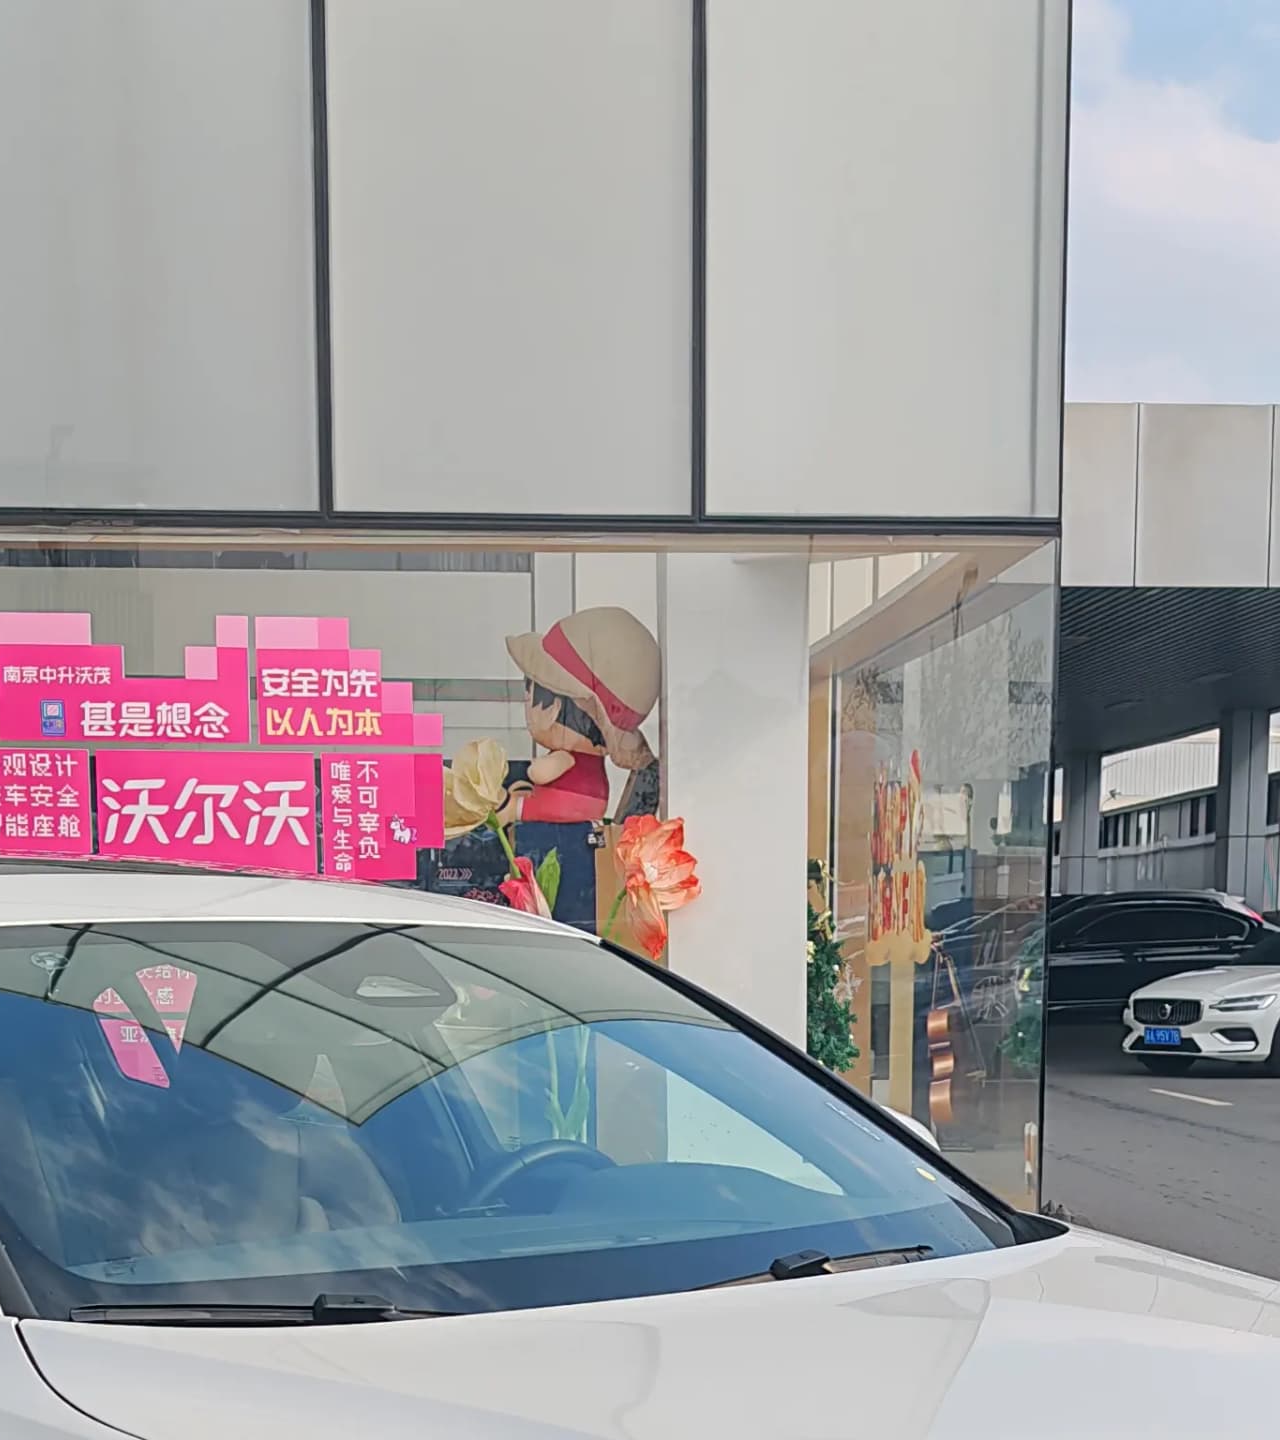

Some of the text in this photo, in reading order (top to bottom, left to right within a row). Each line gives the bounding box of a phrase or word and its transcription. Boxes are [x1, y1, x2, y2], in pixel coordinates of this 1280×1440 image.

[3, 666, 111, 685] 南京中升沃茂
[262, 668, 378, 697] 安全为先
[80, 701, 230, 738] 甚是想念
[266, 707, 382, 736] 以人为本
[102, 778, 310, 845] 沃尔沃
[330, 760, 354, 872] 唯爱与生命
